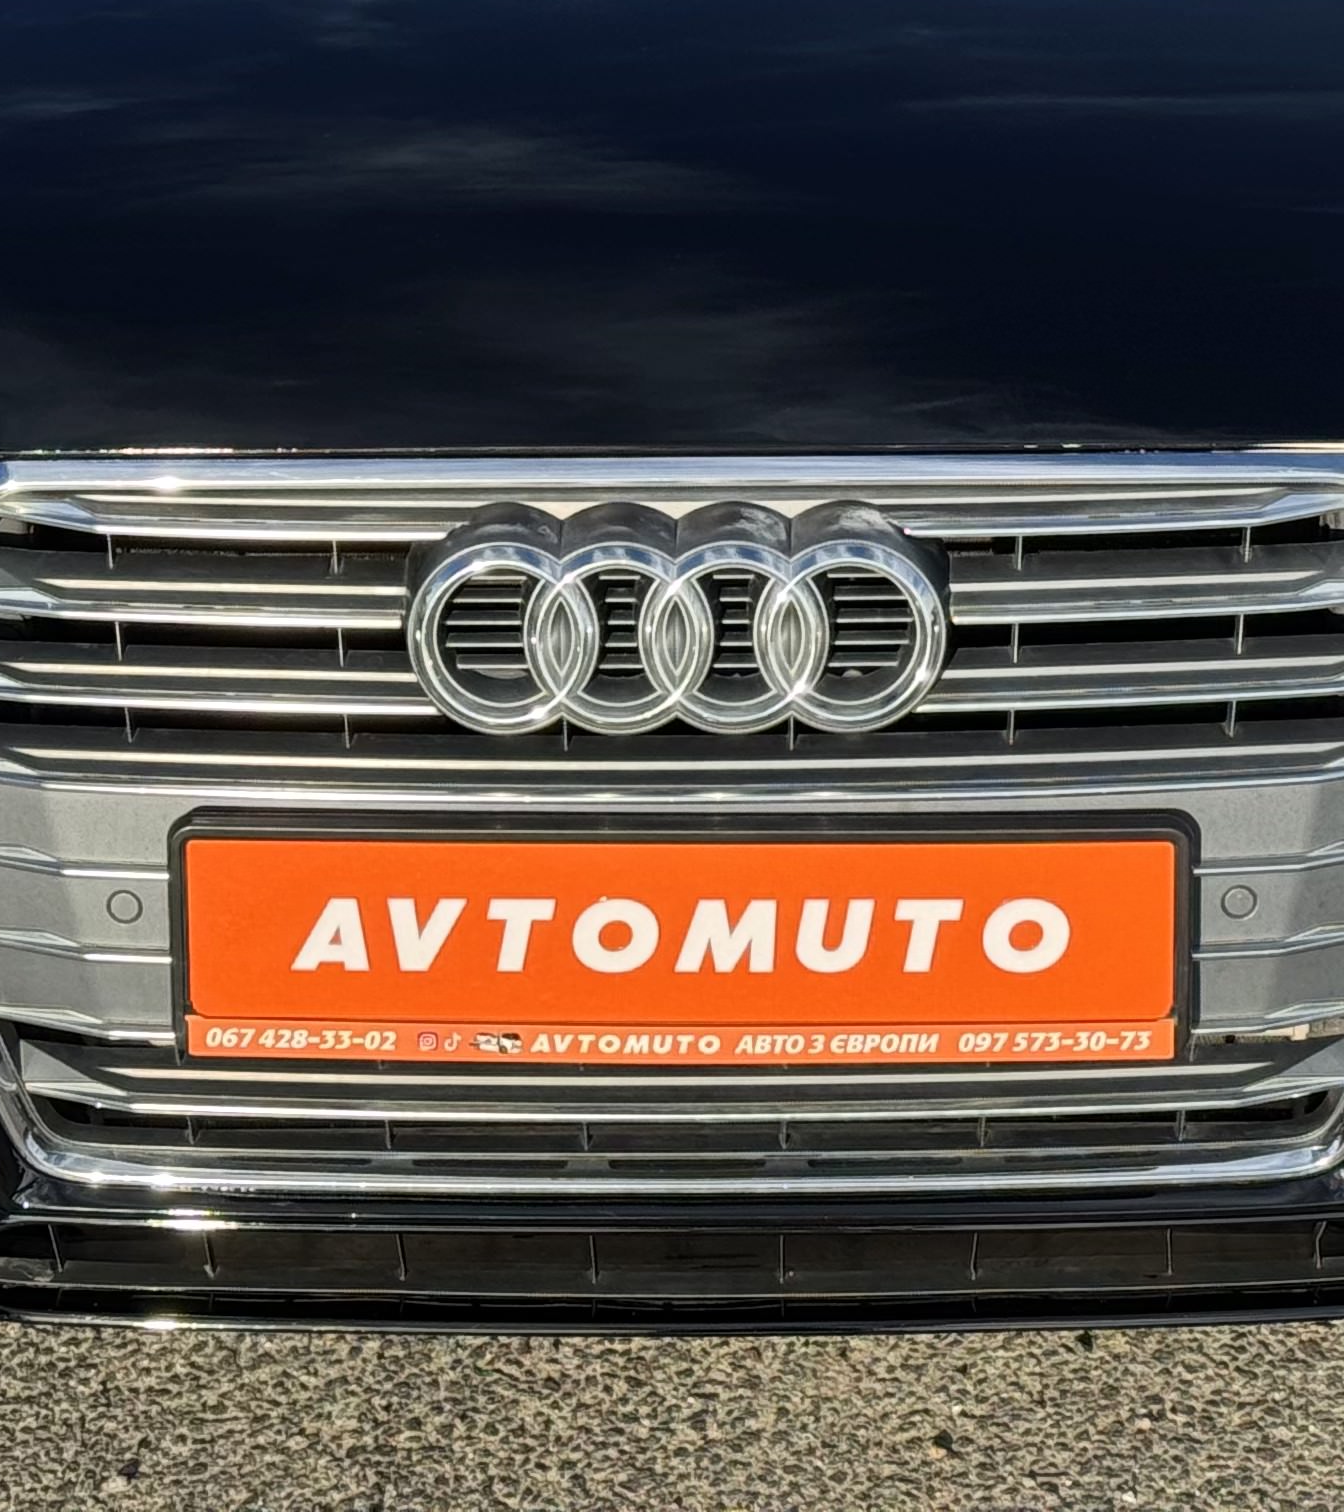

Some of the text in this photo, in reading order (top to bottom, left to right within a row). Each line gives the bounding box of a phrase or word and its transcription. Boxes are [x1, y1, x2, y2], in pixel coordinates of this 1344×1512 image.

[291, 897, 1070, 973] AVTOMUTO
[205, 1027, 396, 1050] 067 428-33-02
[529, 1033, 720, 1053] AVTOMUTO
[734, 1034, 804, 1053] АВТО
[829, 1033, 938, 1052] ЄВРОПИ
[958, 1030, 1151, 1051] 097 573-30-73
